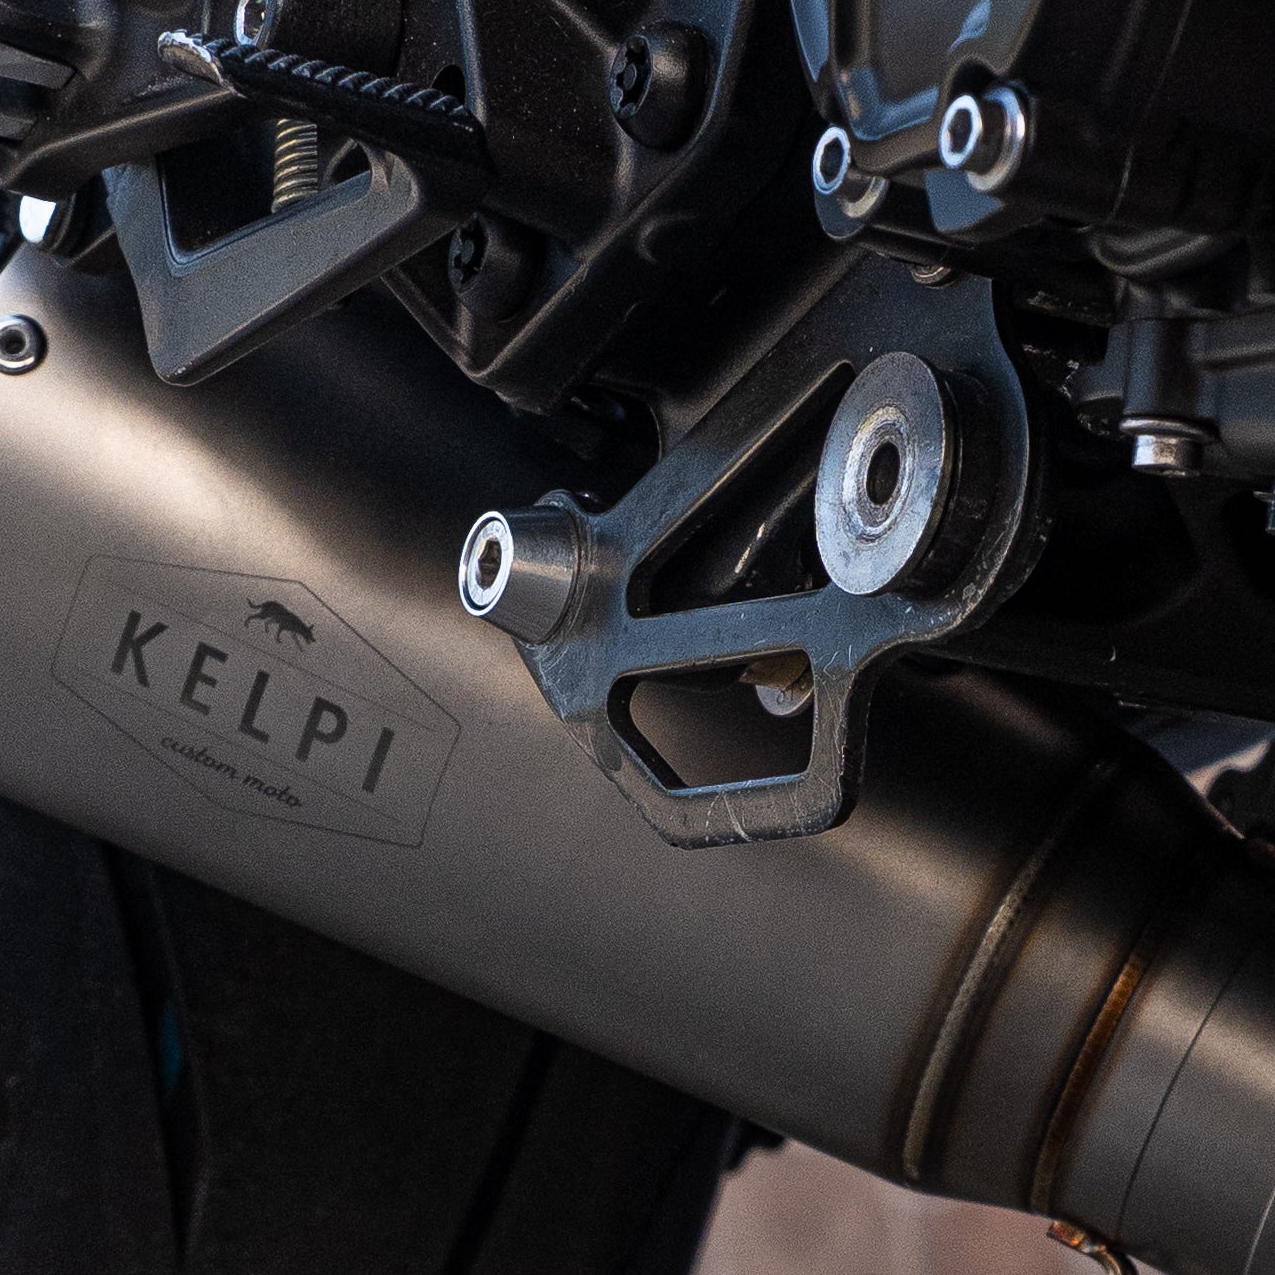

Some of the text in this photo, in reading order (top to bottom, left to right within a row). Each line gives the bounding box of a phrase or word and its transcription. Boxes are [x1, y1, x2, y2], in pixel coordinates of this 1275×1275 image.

[111, 610, 395, 794] KELPI
[160, 736, 303, 808] custom moto
